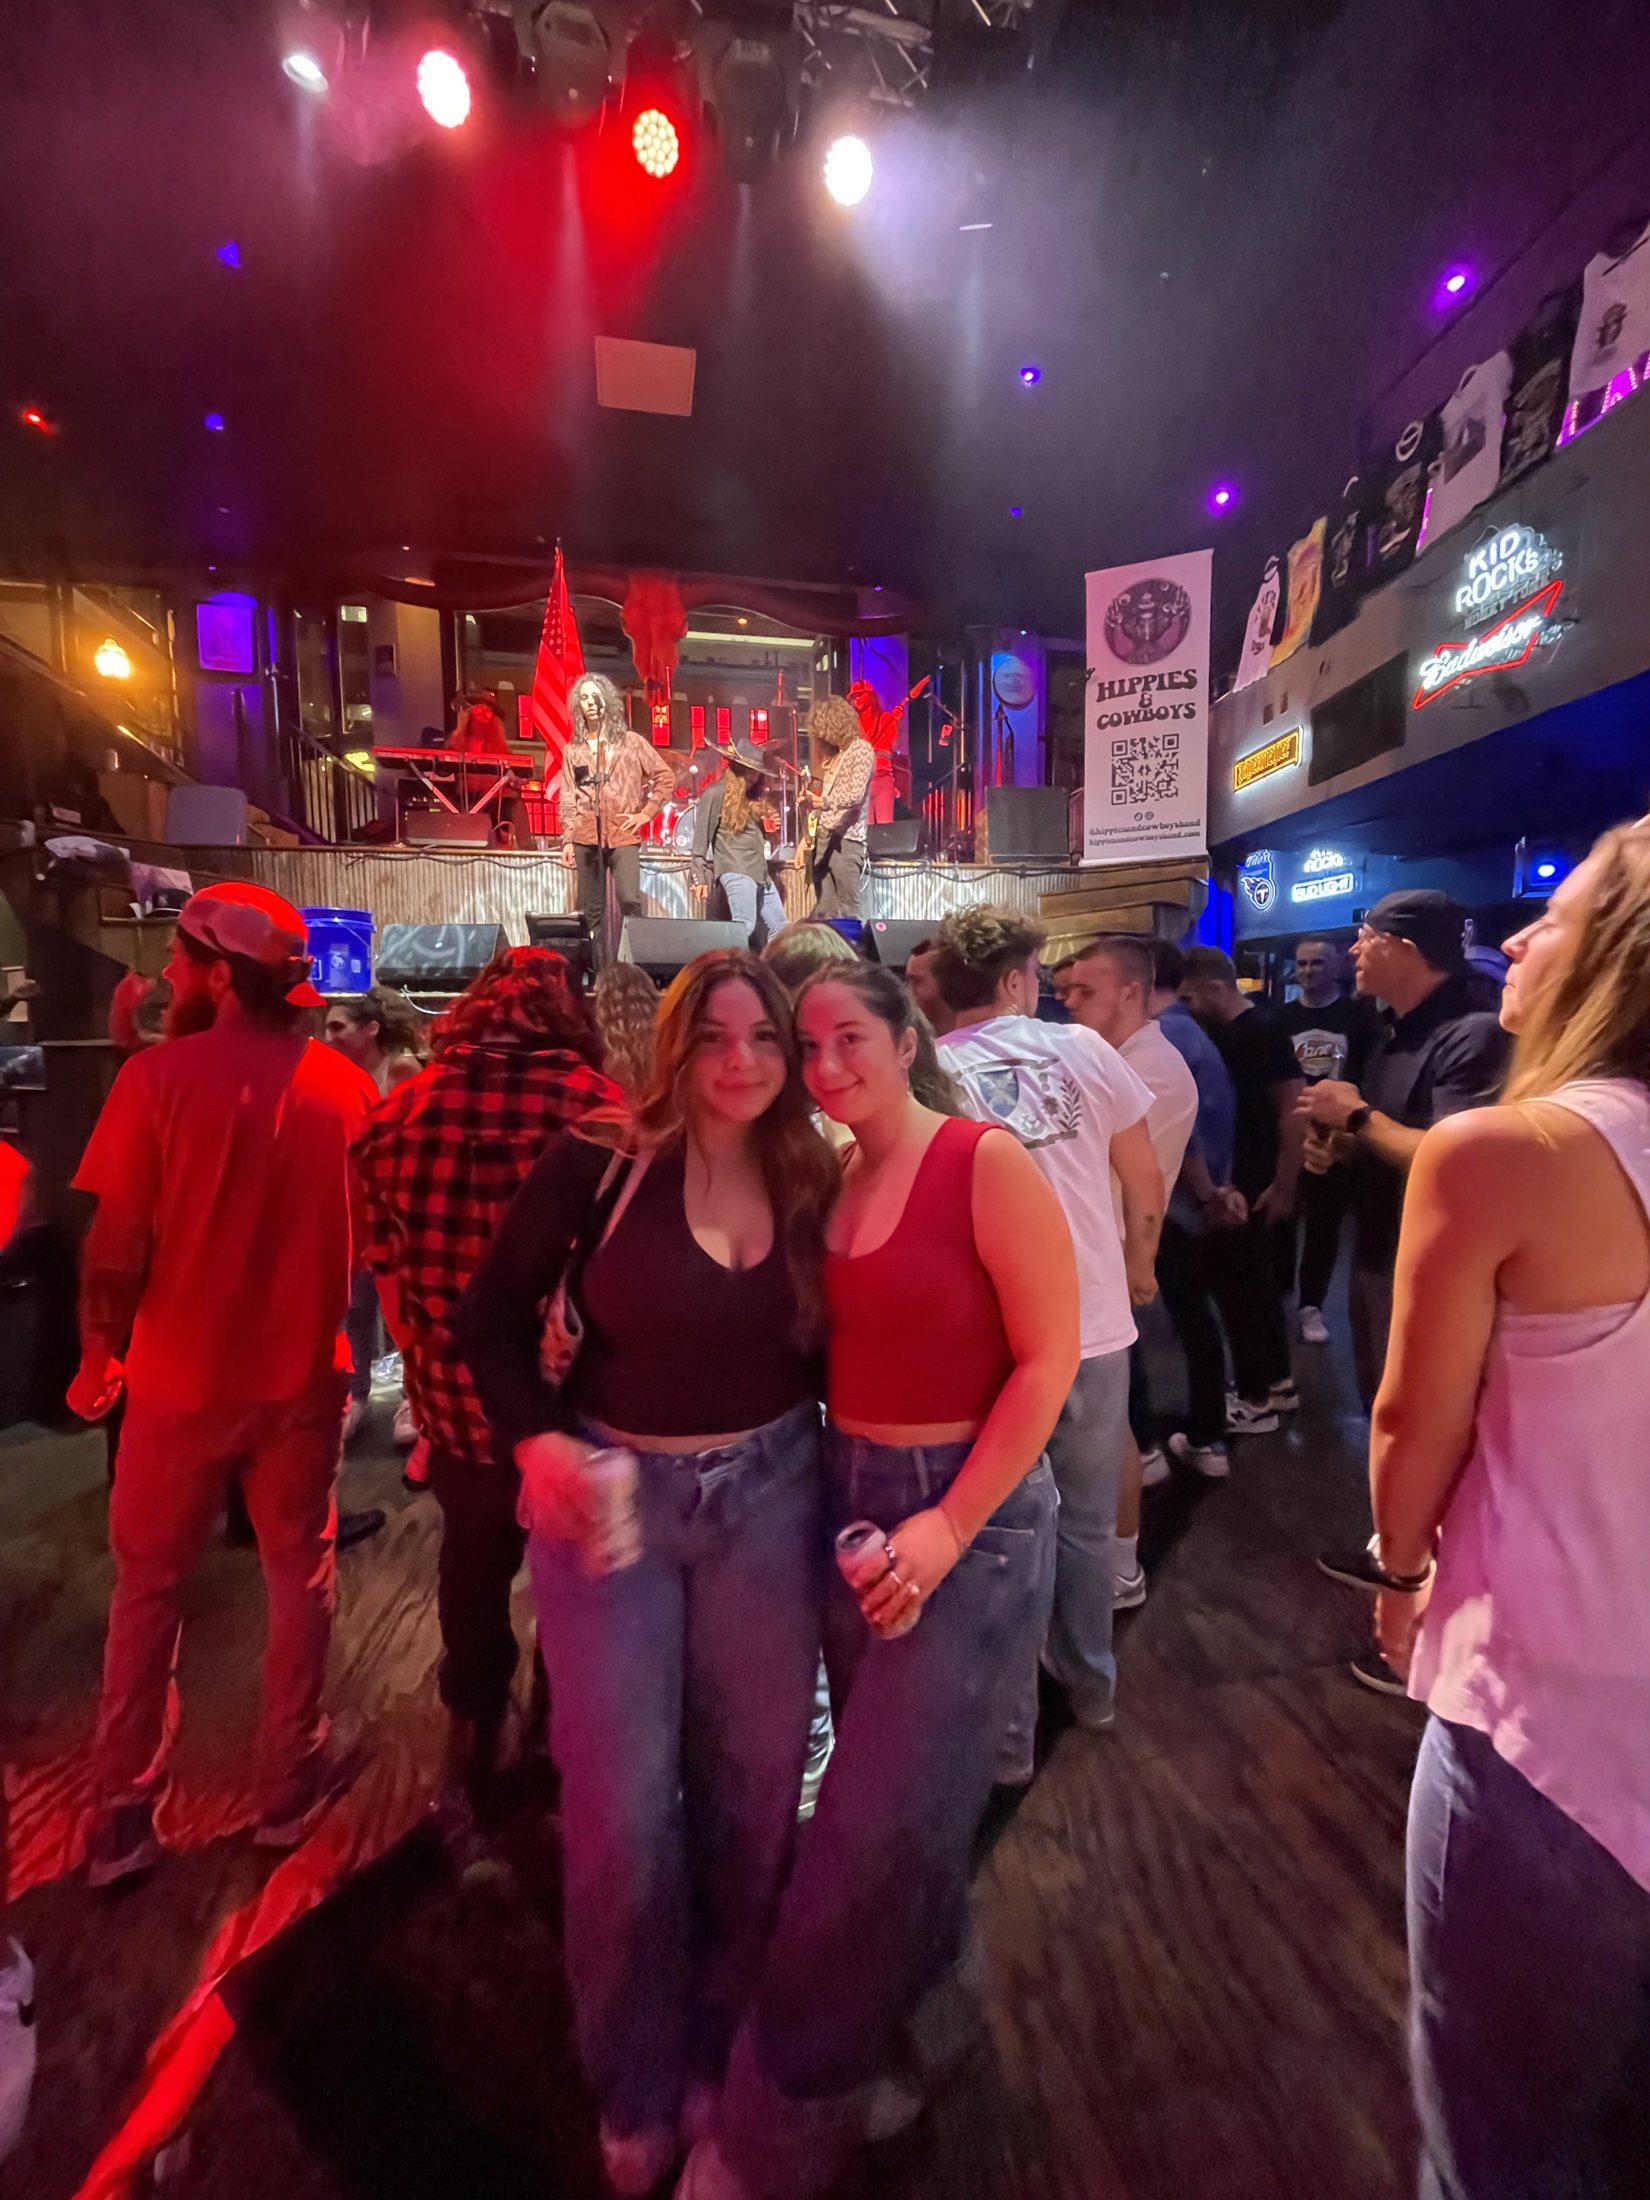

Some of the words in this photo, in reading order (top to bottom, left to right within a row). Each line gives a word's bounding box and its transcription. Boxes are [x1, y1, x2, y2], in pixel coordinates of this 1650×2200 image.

[1469, 532, 1520, 579] KID
[1420, 615, 1542, 689] Budweiser
[1096, 669, 1198, 702] HIPPIES
[1138, 692, 1153, 708] &
[1097, 702, 1196, 730] COWBOYS
